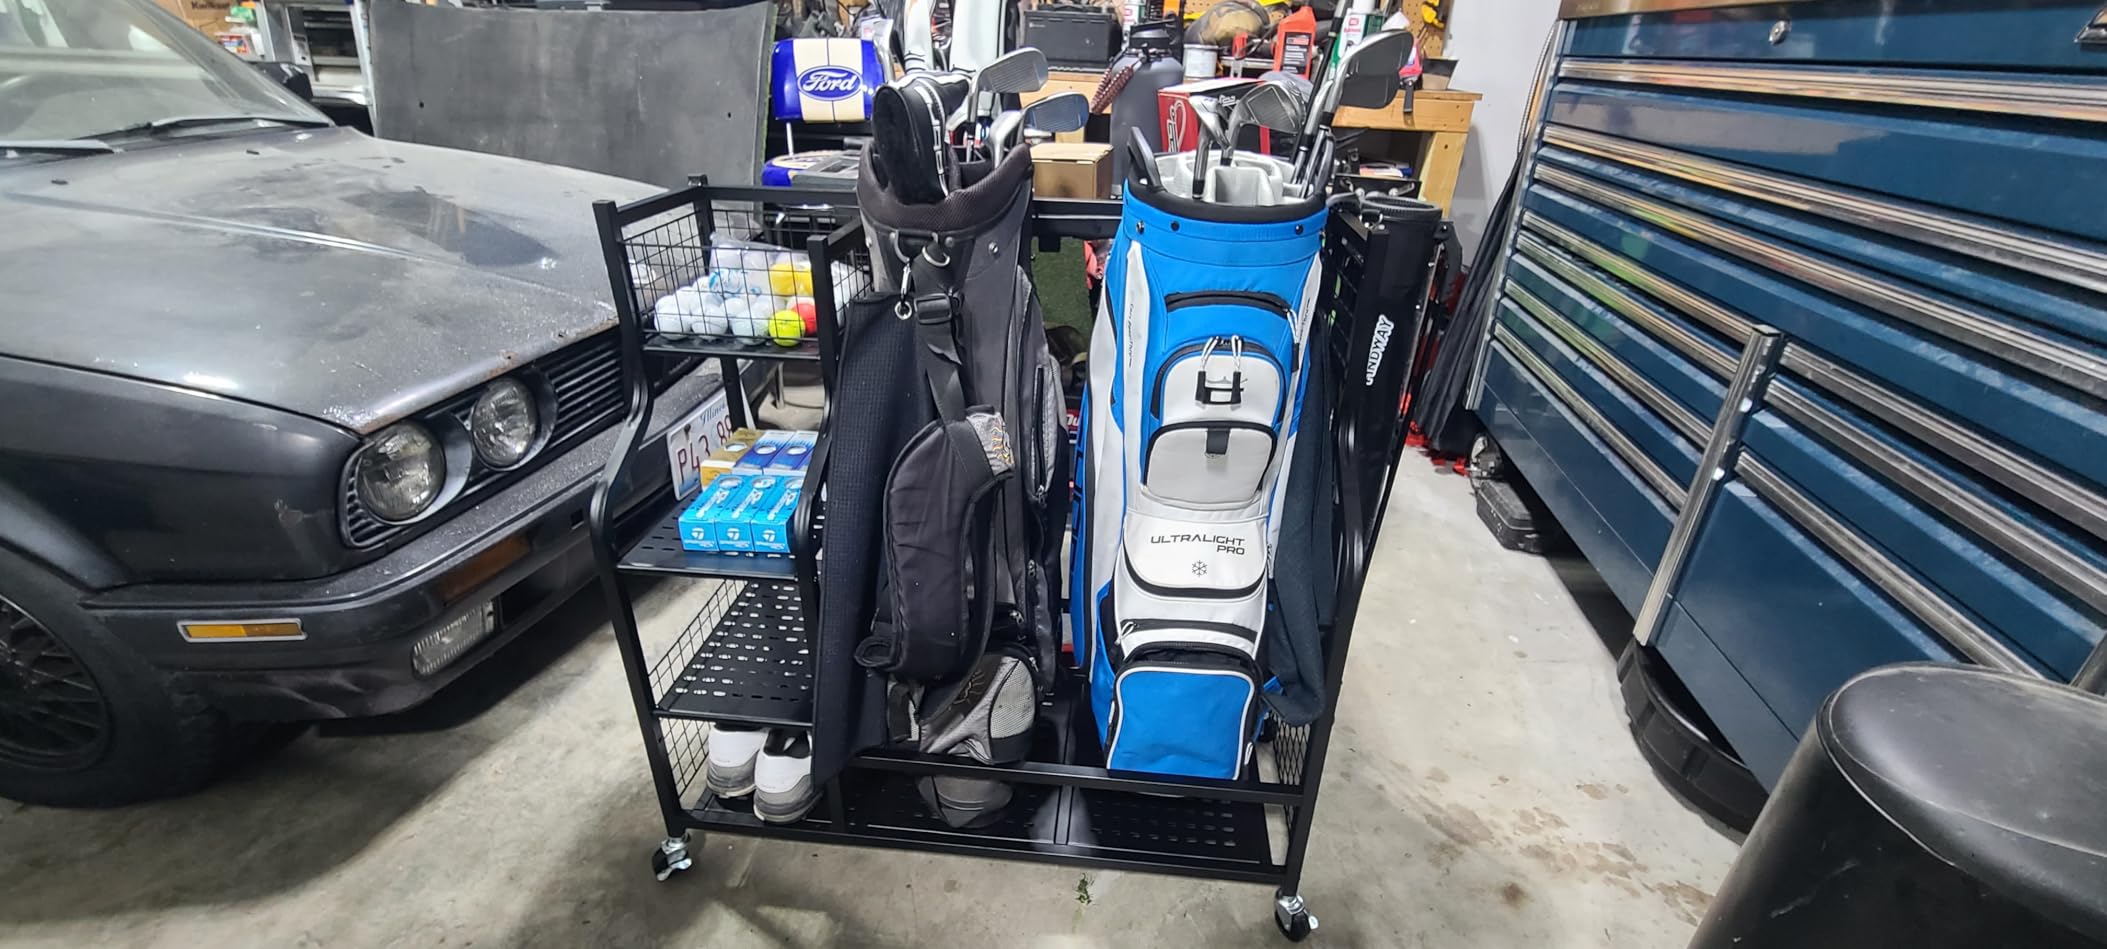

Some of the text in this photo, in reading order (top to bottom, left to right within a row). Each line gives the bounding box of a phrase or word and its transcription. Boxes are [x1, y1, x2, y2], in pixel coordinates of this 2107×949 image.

[803, 71, 857, 91] Ford
[677, 434, 711, 485] P43
[1151, 534, 1245, 546] ULTRALIGHT
[1217, 545, 1245, 555] PRO
